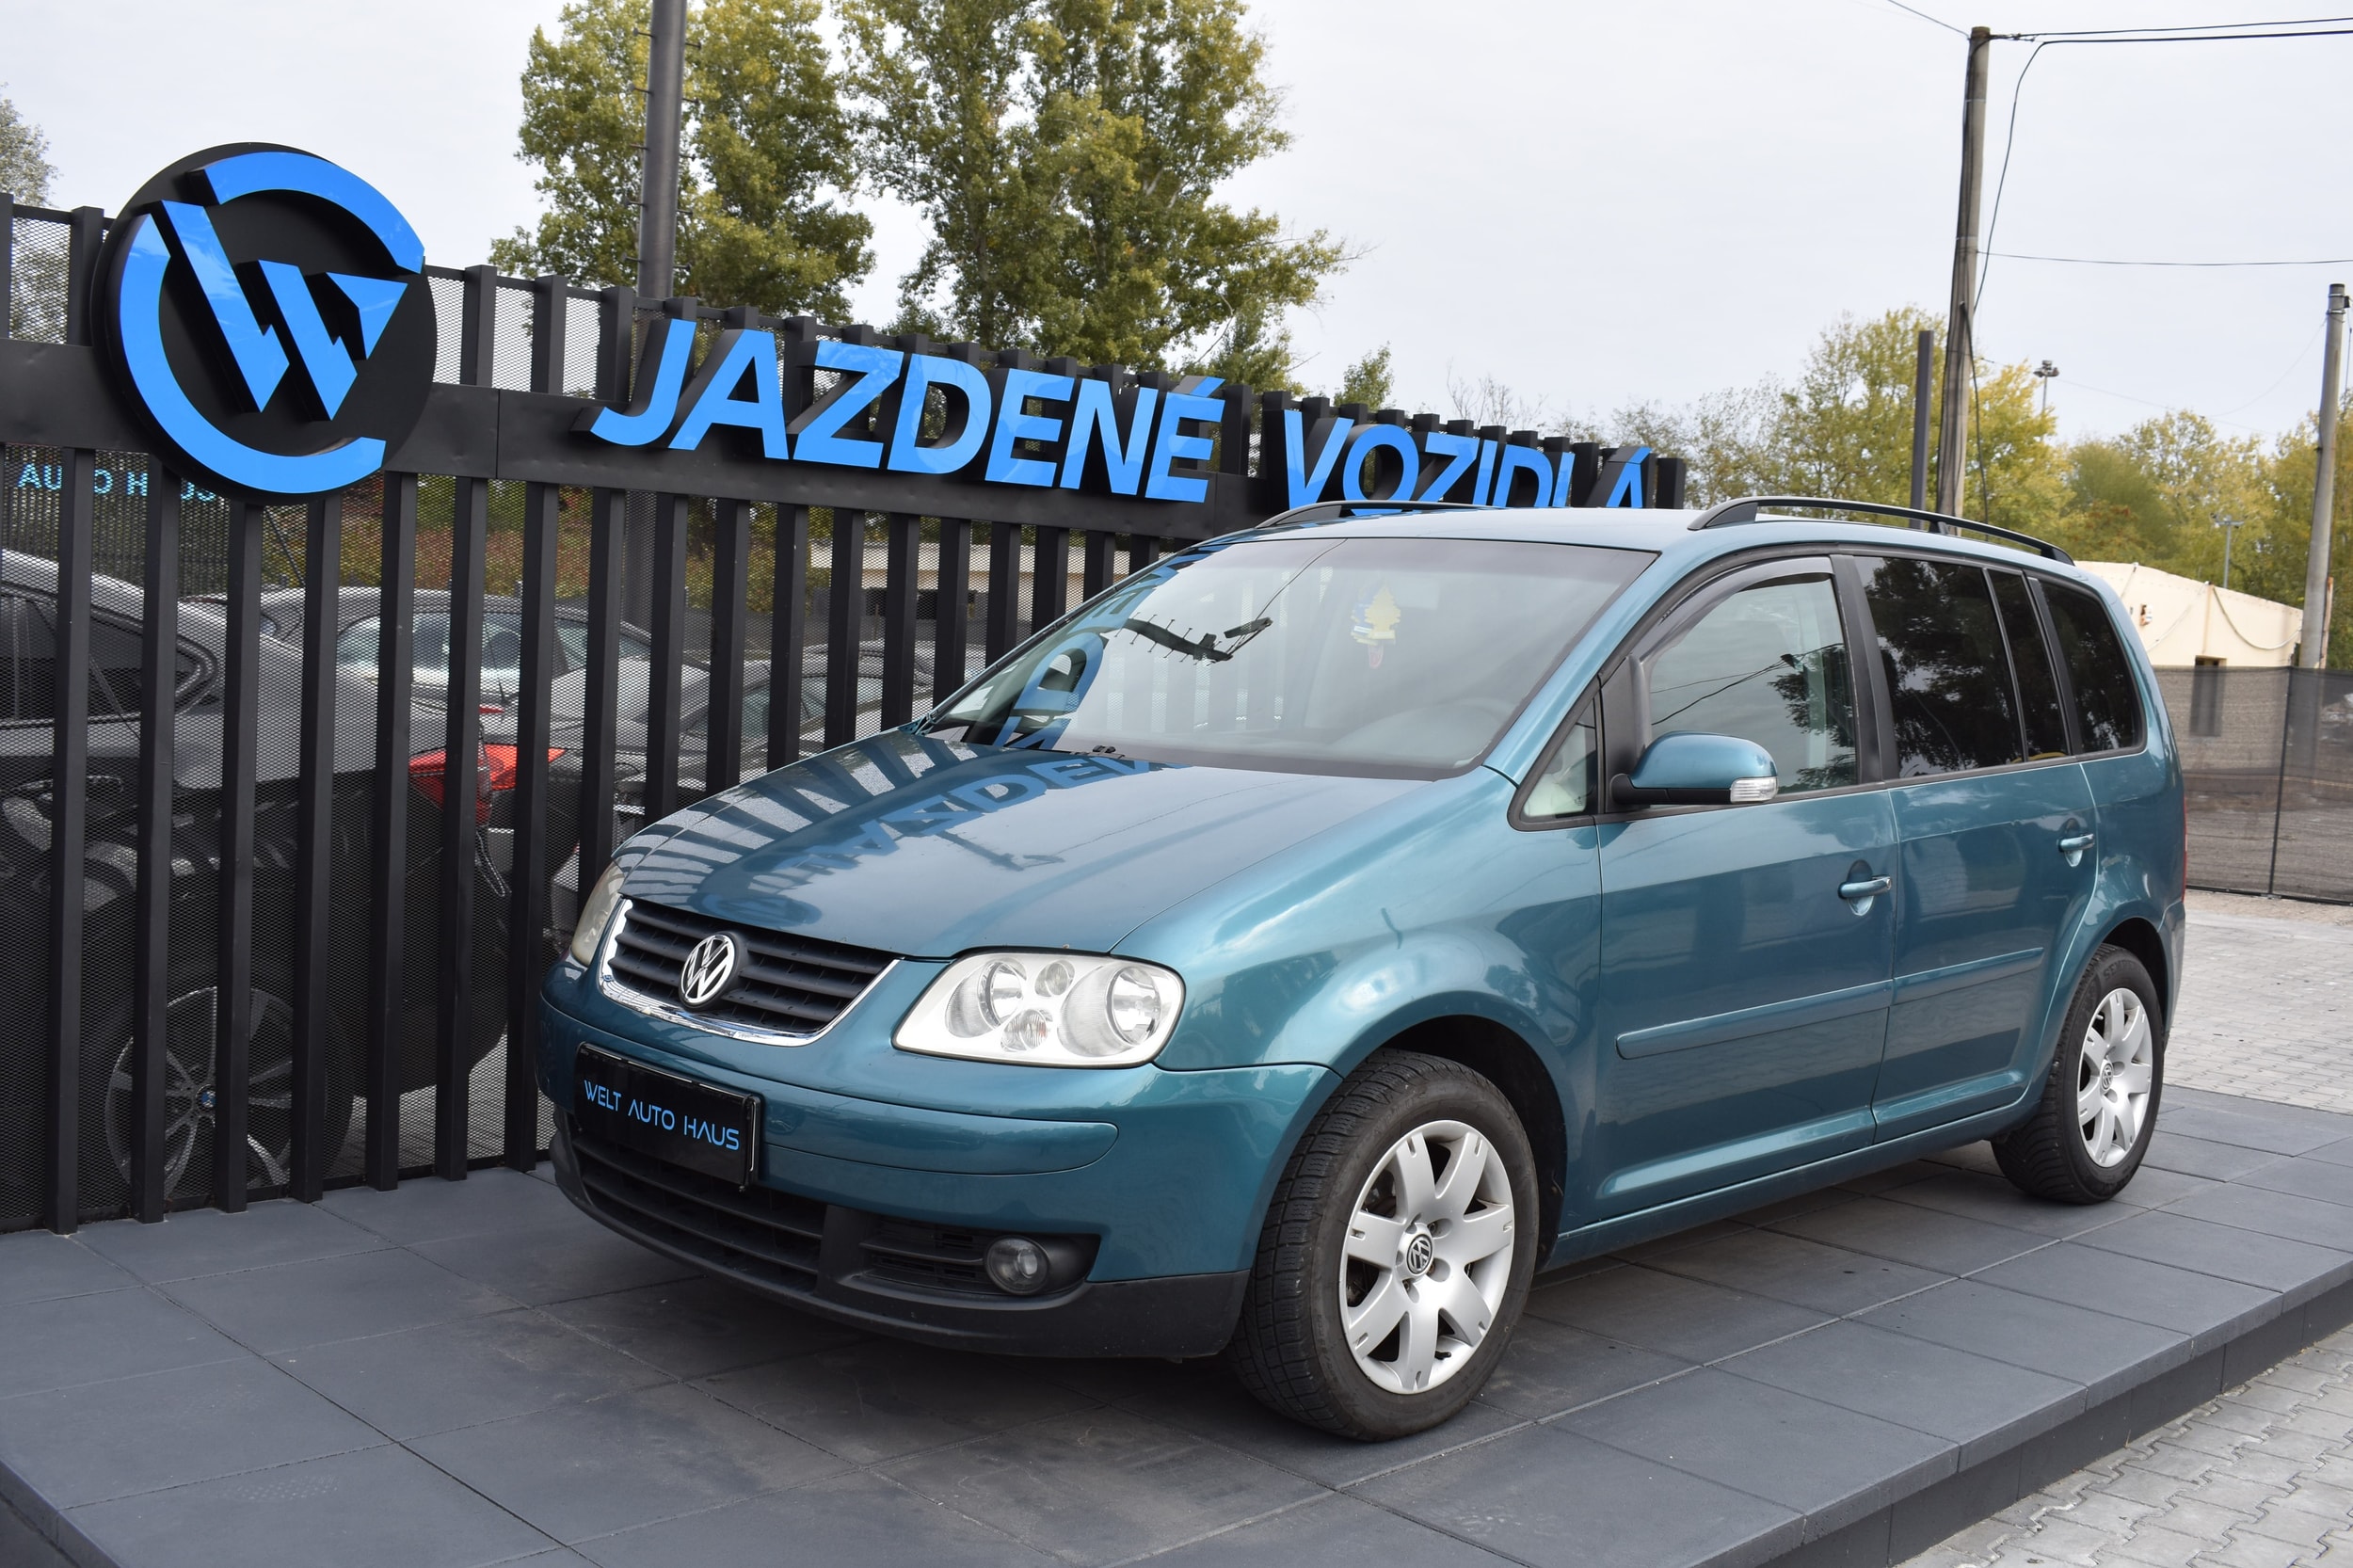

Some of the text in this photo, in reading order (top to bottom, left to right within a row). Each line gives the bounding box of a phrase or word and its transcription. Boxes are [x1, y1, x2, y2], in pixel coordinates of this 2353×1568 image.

[589, 318, 1225, 503] JAZDENÉ
[17, 463, 114, 494] AUO
[680, 932, 736, 1004] VW
[584, 1080, 740, 1151] WELT AUTO HAUS
